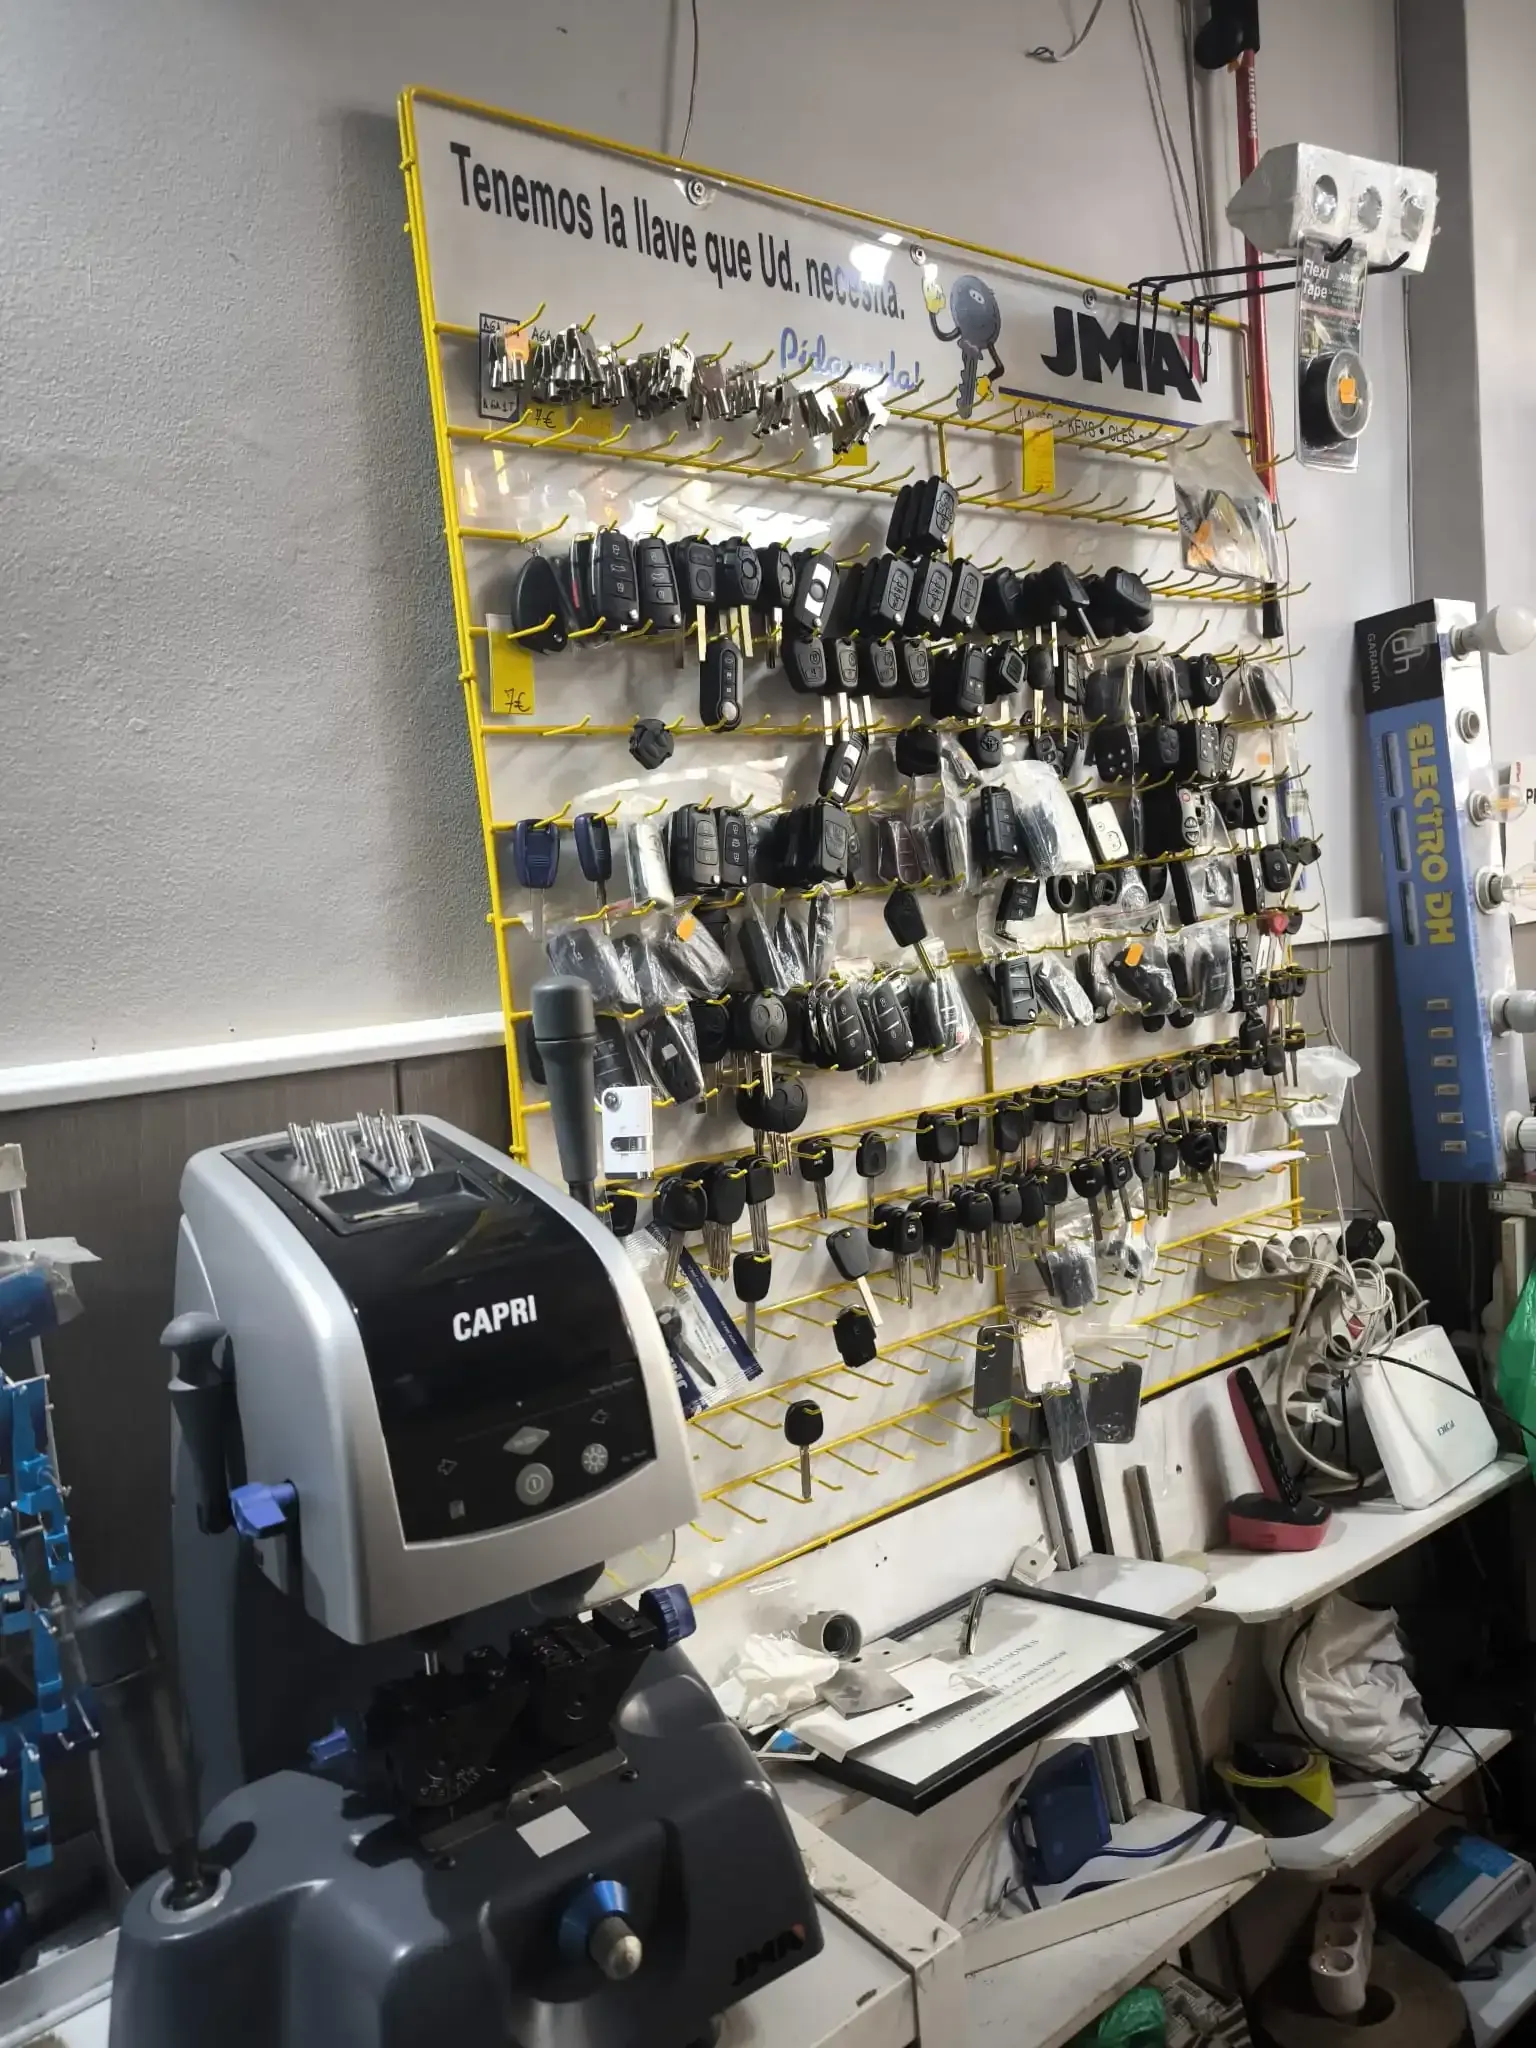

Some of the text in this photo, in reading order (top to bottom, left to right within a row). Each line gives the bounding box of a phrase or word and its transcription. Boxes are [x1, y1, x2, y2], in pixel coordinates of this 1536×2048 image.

[450, 141, 593, 239] Tenemos
[601, 185, 628, 249] la
[633, 196, 698, 268] llave
[705, 231, 751, 289] que
[758, 232, 800, 293] Ud.
[1303, 258, 1330, 280] Flexi
[1303, 278, 1328, 300] Tape
[1041, 306, 1203, 403] JMA
[504, 687, 531, 713] 7€
[1407, 722, 1457, 945] ELECTRO DH
[452, 1294, 538, 1342] CAPRI
